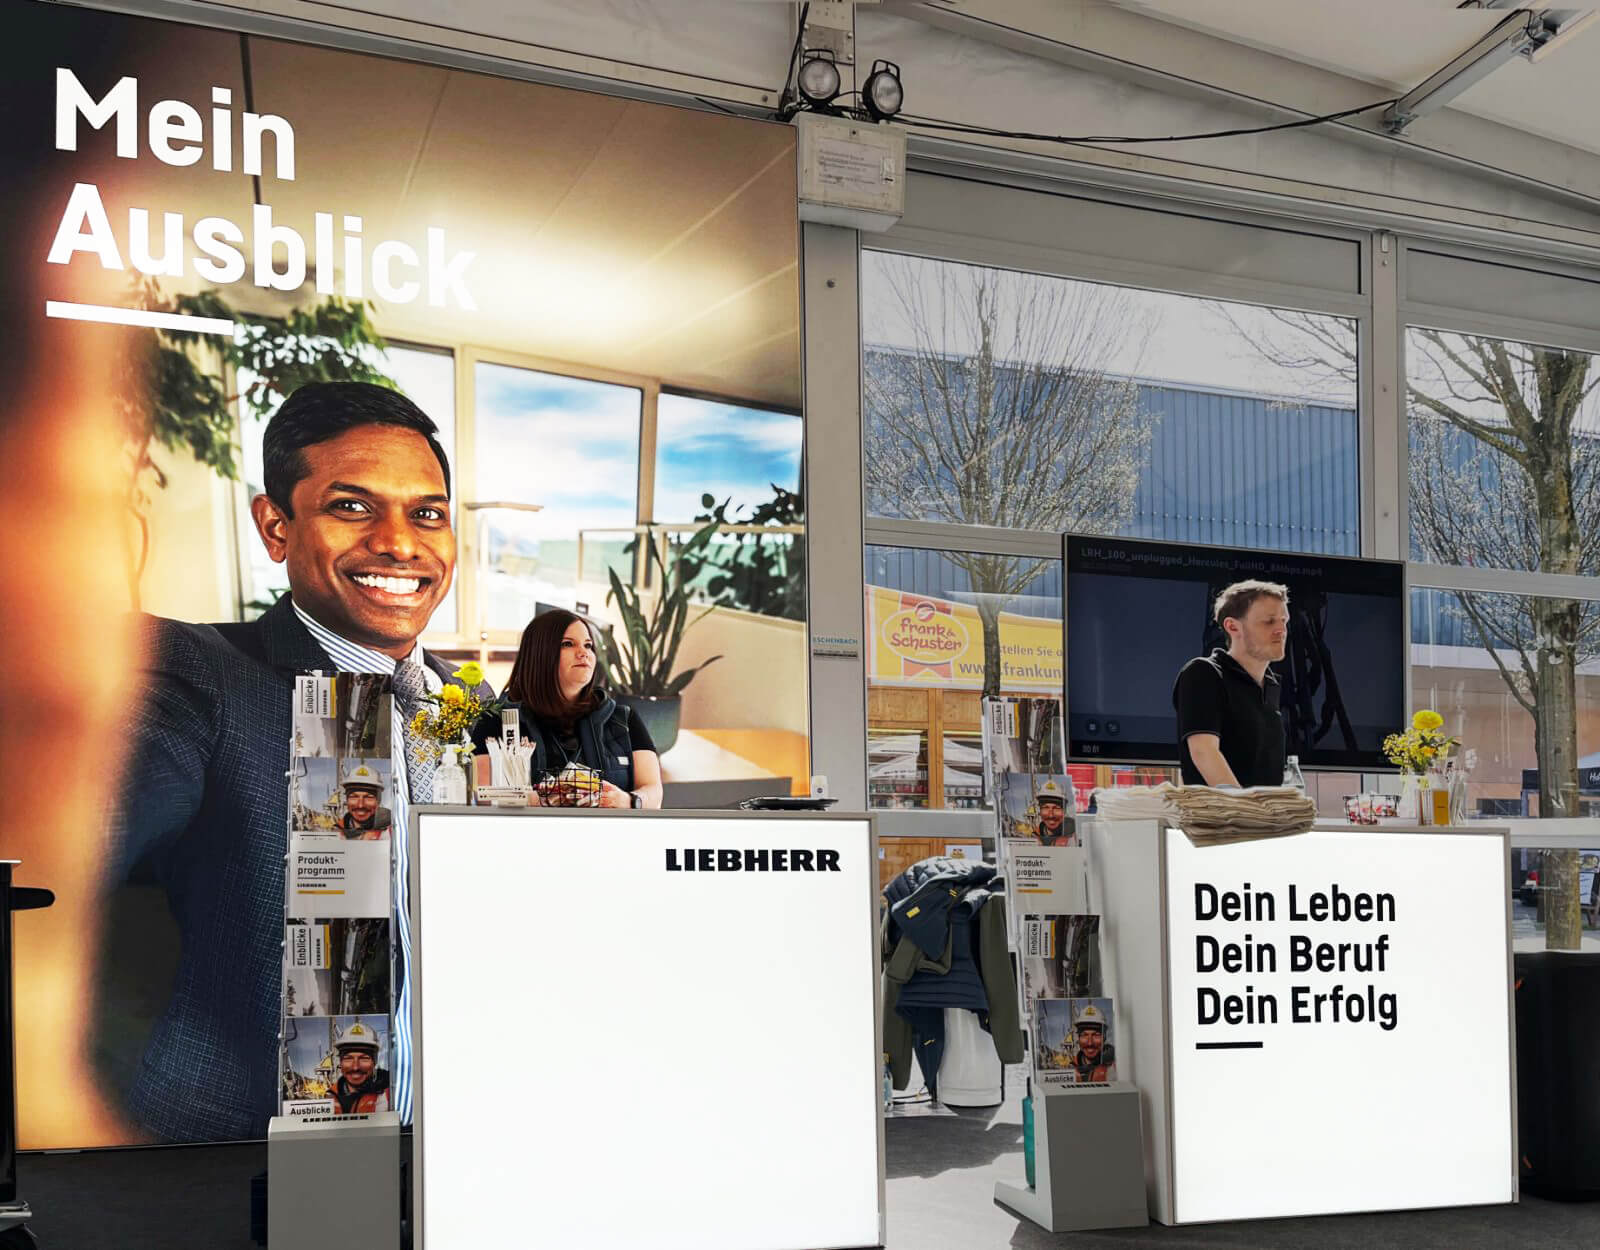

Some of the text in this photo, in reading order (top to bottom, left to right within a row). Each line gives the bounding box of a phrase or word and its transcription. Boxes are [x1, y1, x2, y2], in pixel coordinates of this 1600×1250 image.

[54, 67, 296, 182] Mein
[46, 182, 479, 313] Ausblick
[891, 632, 962, 651] Schuster
[1036, 646, 1053, 657] Sie
[304, 679, 314, 714] Einblicke
[297, 855, 338, 865] Produkt-
[666, 849, 841, 871] LIEBHERR
[1015, 859, 1046, 868] Produkt-
[297, 867, 345, 877] programm
[1016, 869, 1052, 878] programm
[1195, 883, 1396, 922] Dein Leben
[296, 928, 306, 966] Einblicke
[1196, 935, 1390, 973] Dein Beruf
[1197, 985, 1399, 1031] Dein Erfolg
[290, 1106, 331, 1115] Ausblicke
